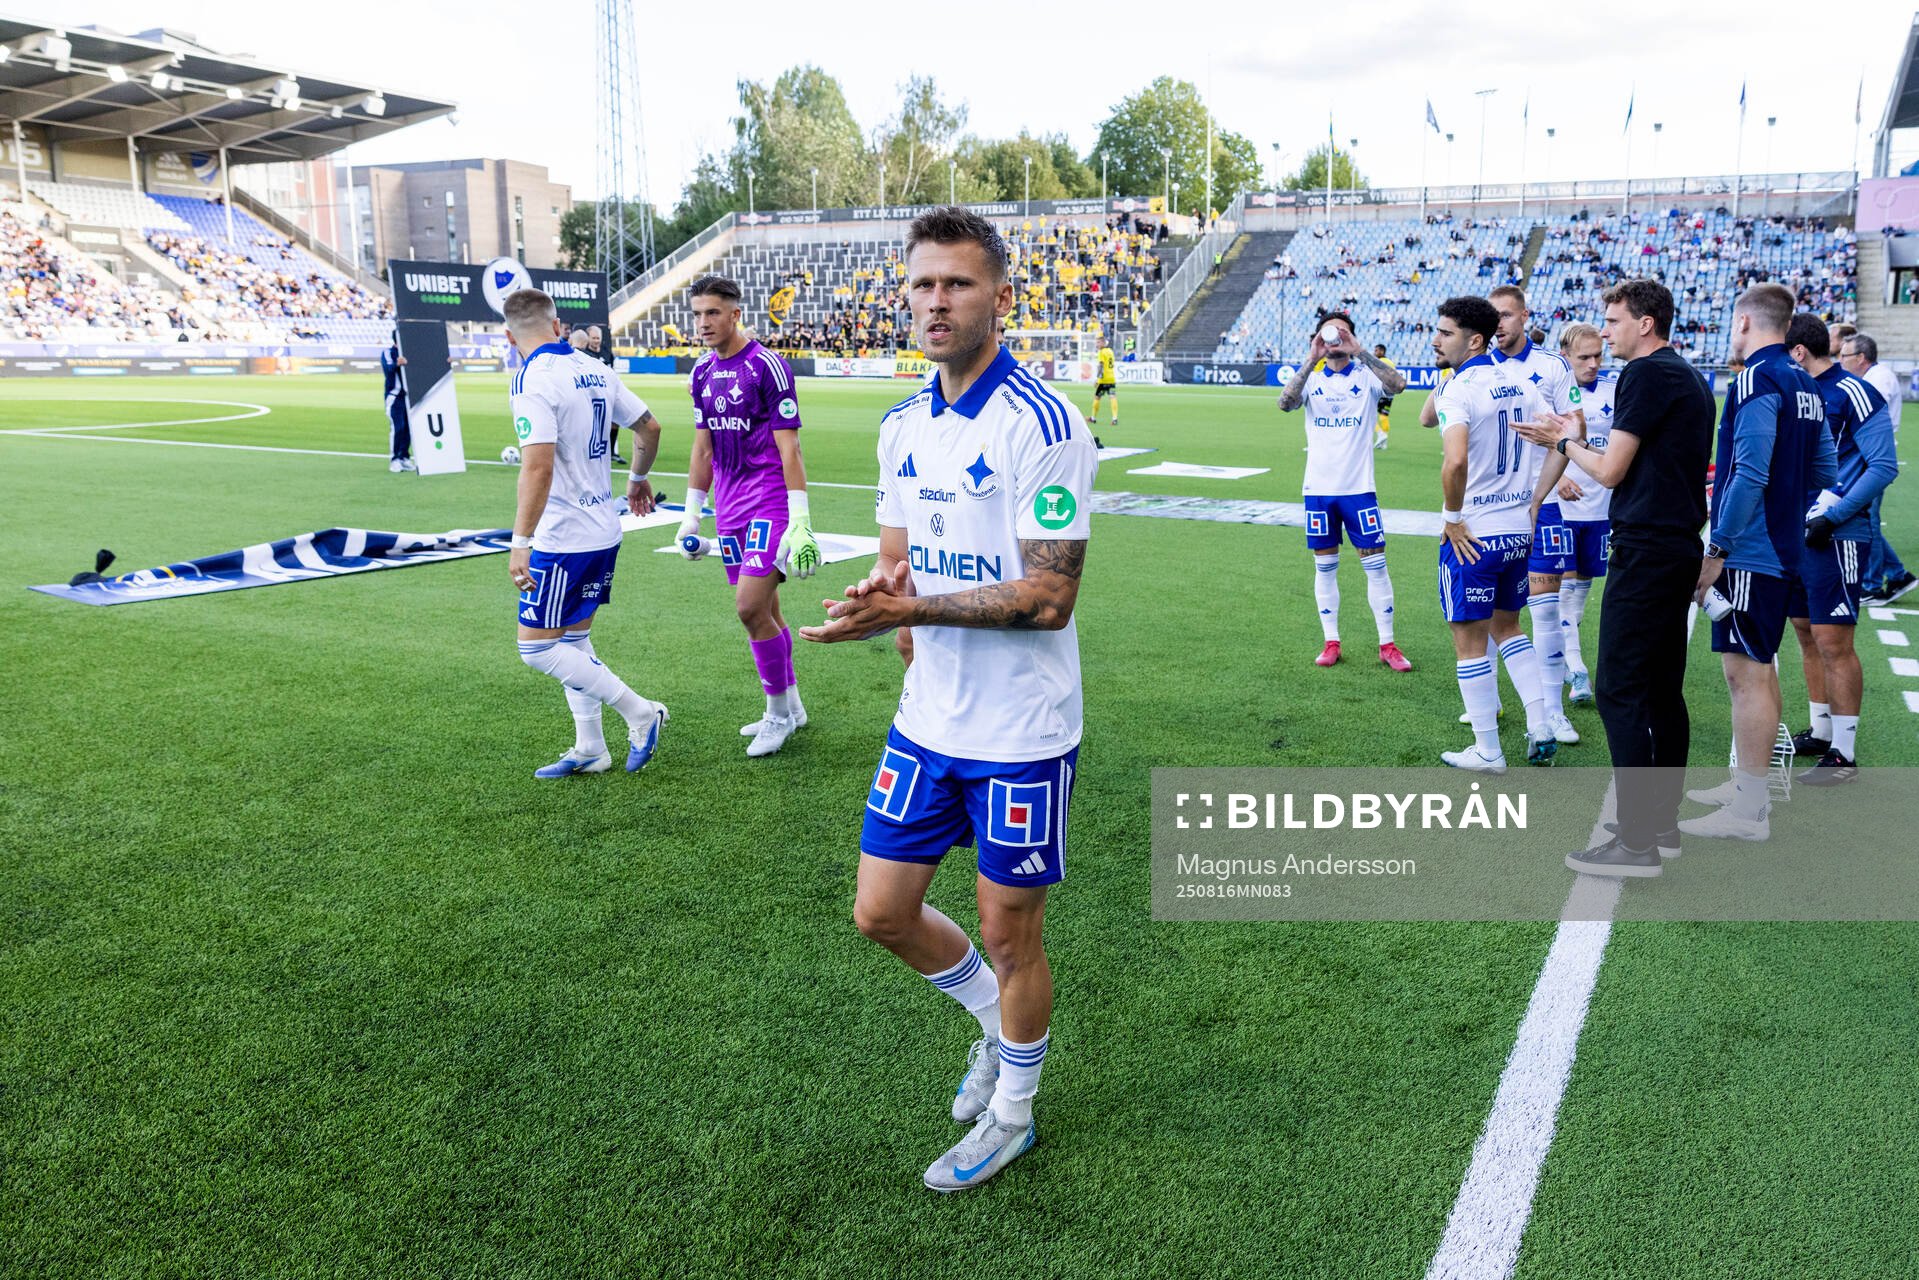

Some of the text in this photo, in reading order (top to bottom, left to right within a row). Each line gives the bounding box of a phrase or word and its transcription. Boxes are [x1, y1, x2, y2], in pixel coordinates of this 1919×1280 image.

[405, 273, 471, 294] UNIBET
[542, 281, 598, 299] UNIBET
[1117, 366, 1158, 380] Smith
[1193, 365, 1243, 383] Brixo.
[427, 413, 444, 437] U
[1497, 408, 1523, 475] 11
[919, 487, 956, 503] stadium
[908, 545, 1002, 582] OLMEN
[1465, 587, 1483, 596] pre
[1466, 595, 1489, 603] zero
